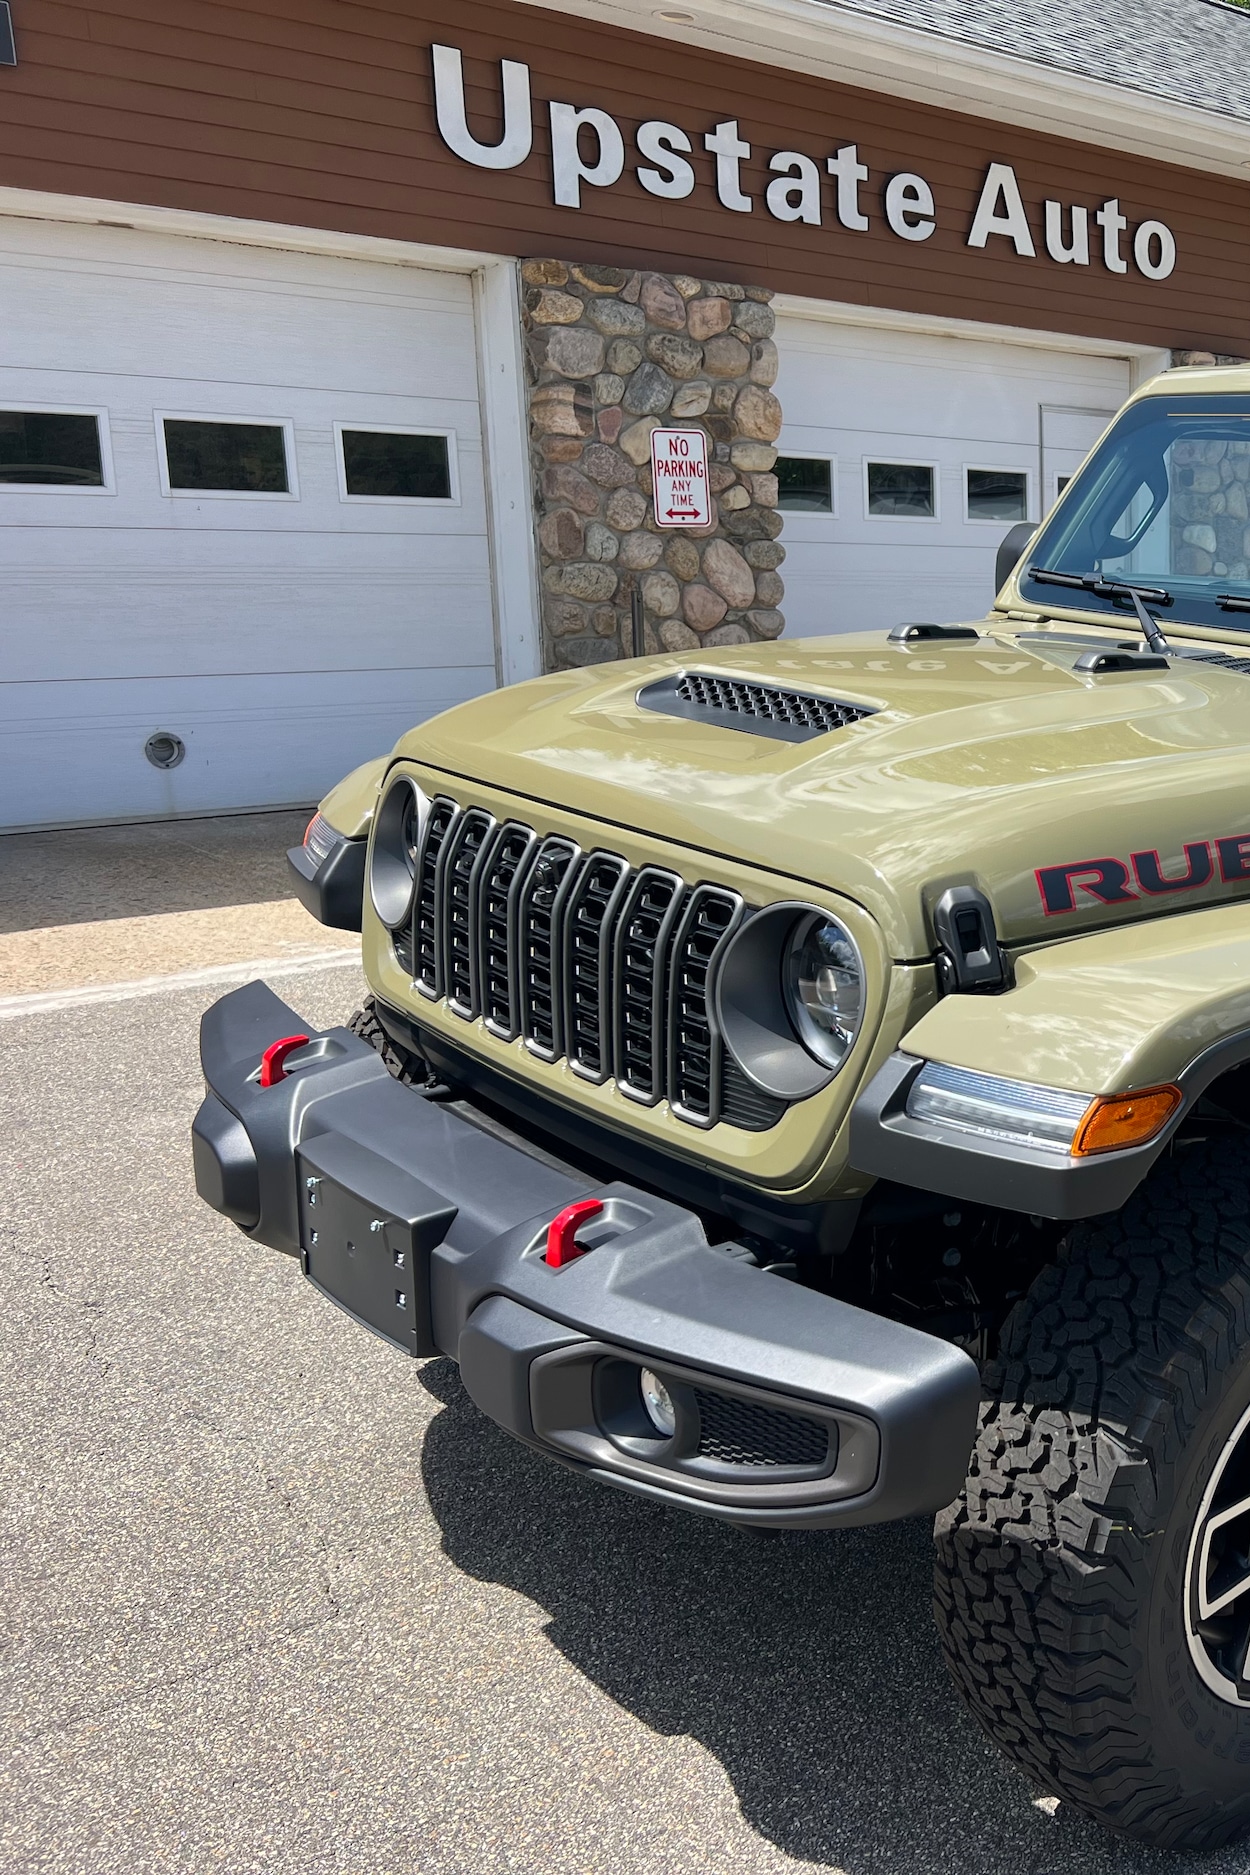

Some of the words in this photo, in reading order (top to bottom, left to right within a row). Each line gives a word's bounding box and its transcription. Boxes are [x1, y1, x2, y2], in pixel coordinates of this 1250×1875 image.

[430, 43, 936, 241] Upstate
[966, 161, 1177, 281] Auto
[669, 438, 689, 456] NO
[657, 460, 704, 478] PARKING
[671, 480, 692, 492] ANY
[671, 494, 694, 506] TIME
